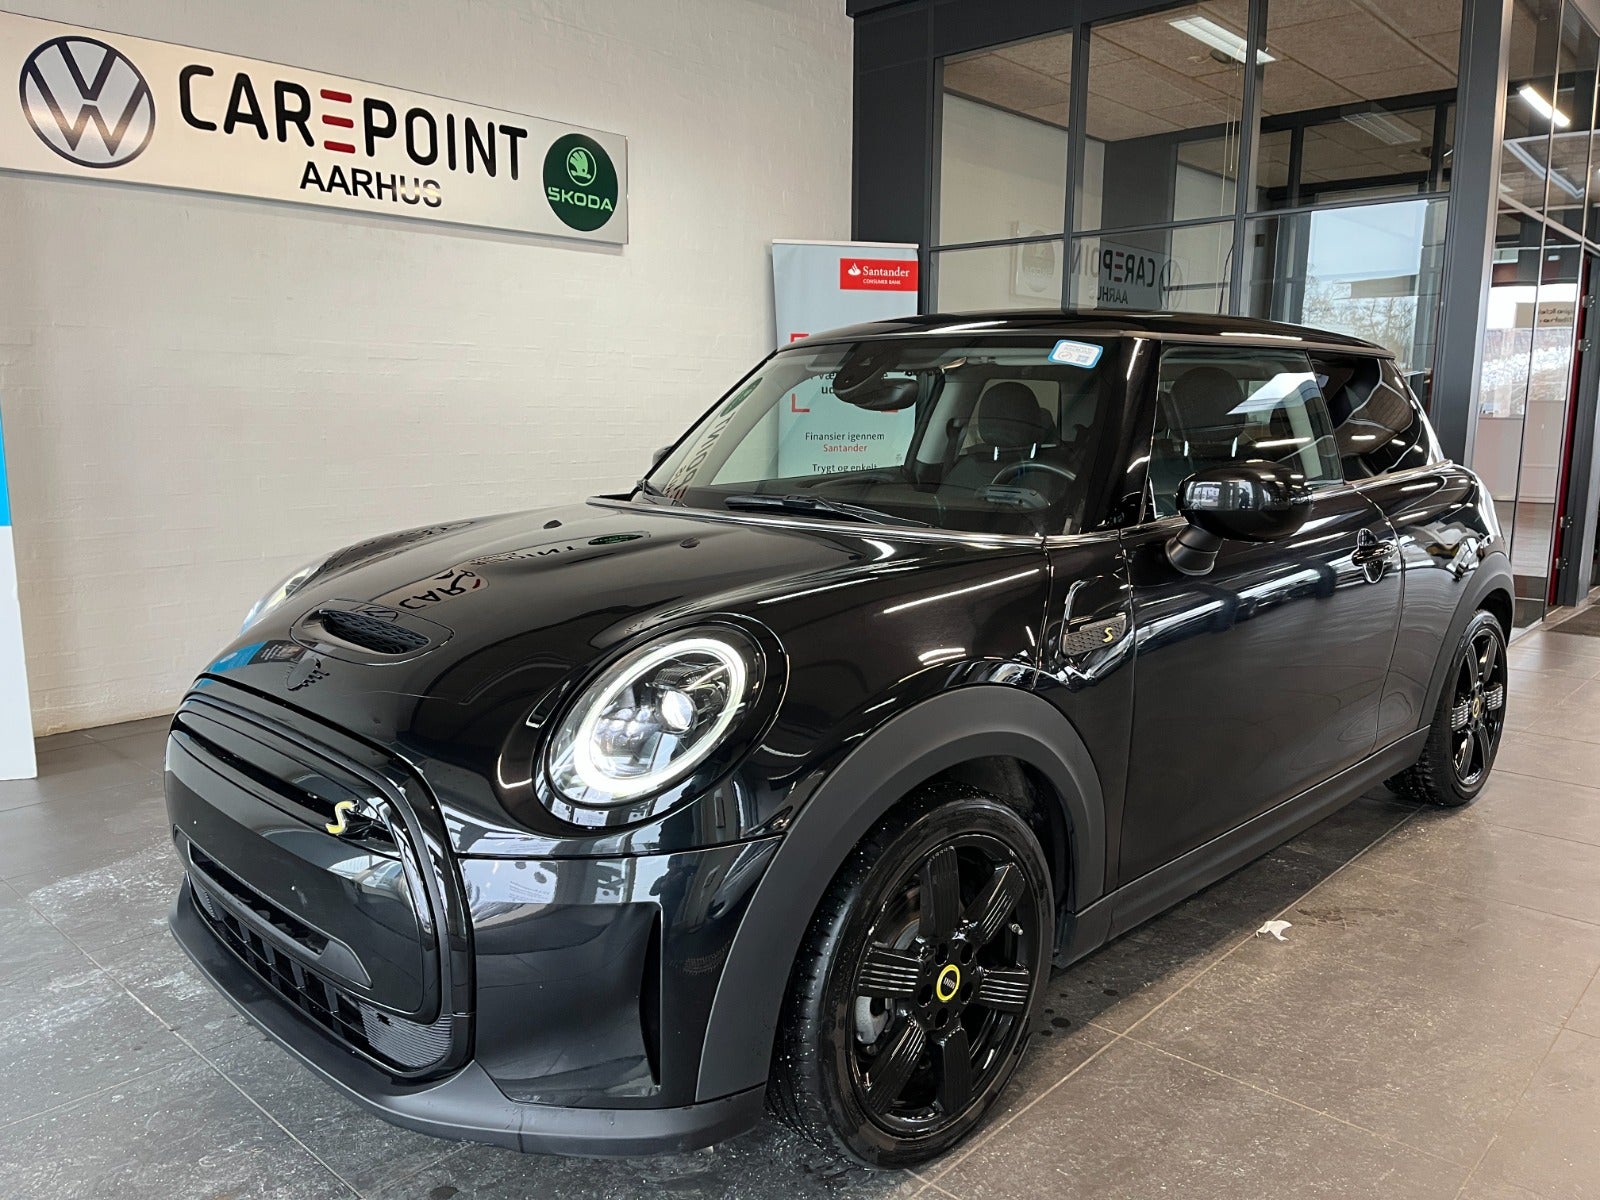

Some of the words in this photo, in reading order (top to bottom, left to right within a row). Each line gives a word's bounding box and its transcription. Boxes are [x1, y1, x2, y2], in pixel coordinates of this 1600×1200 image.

[179, 64, 528, 181] CAREPOINT
[300, 161, 442, 208] AARHUS
[862, 265, 910, 277] Santander
[805, 432, 846, 441] Finansier
[847, 432, 885, 442] igennem
[823, 444, 868, 452] Santander
[812, 463, 836, 473] Trygt
[1102, 626, 1114, 643] S
[325, 800, 356, 836] S
